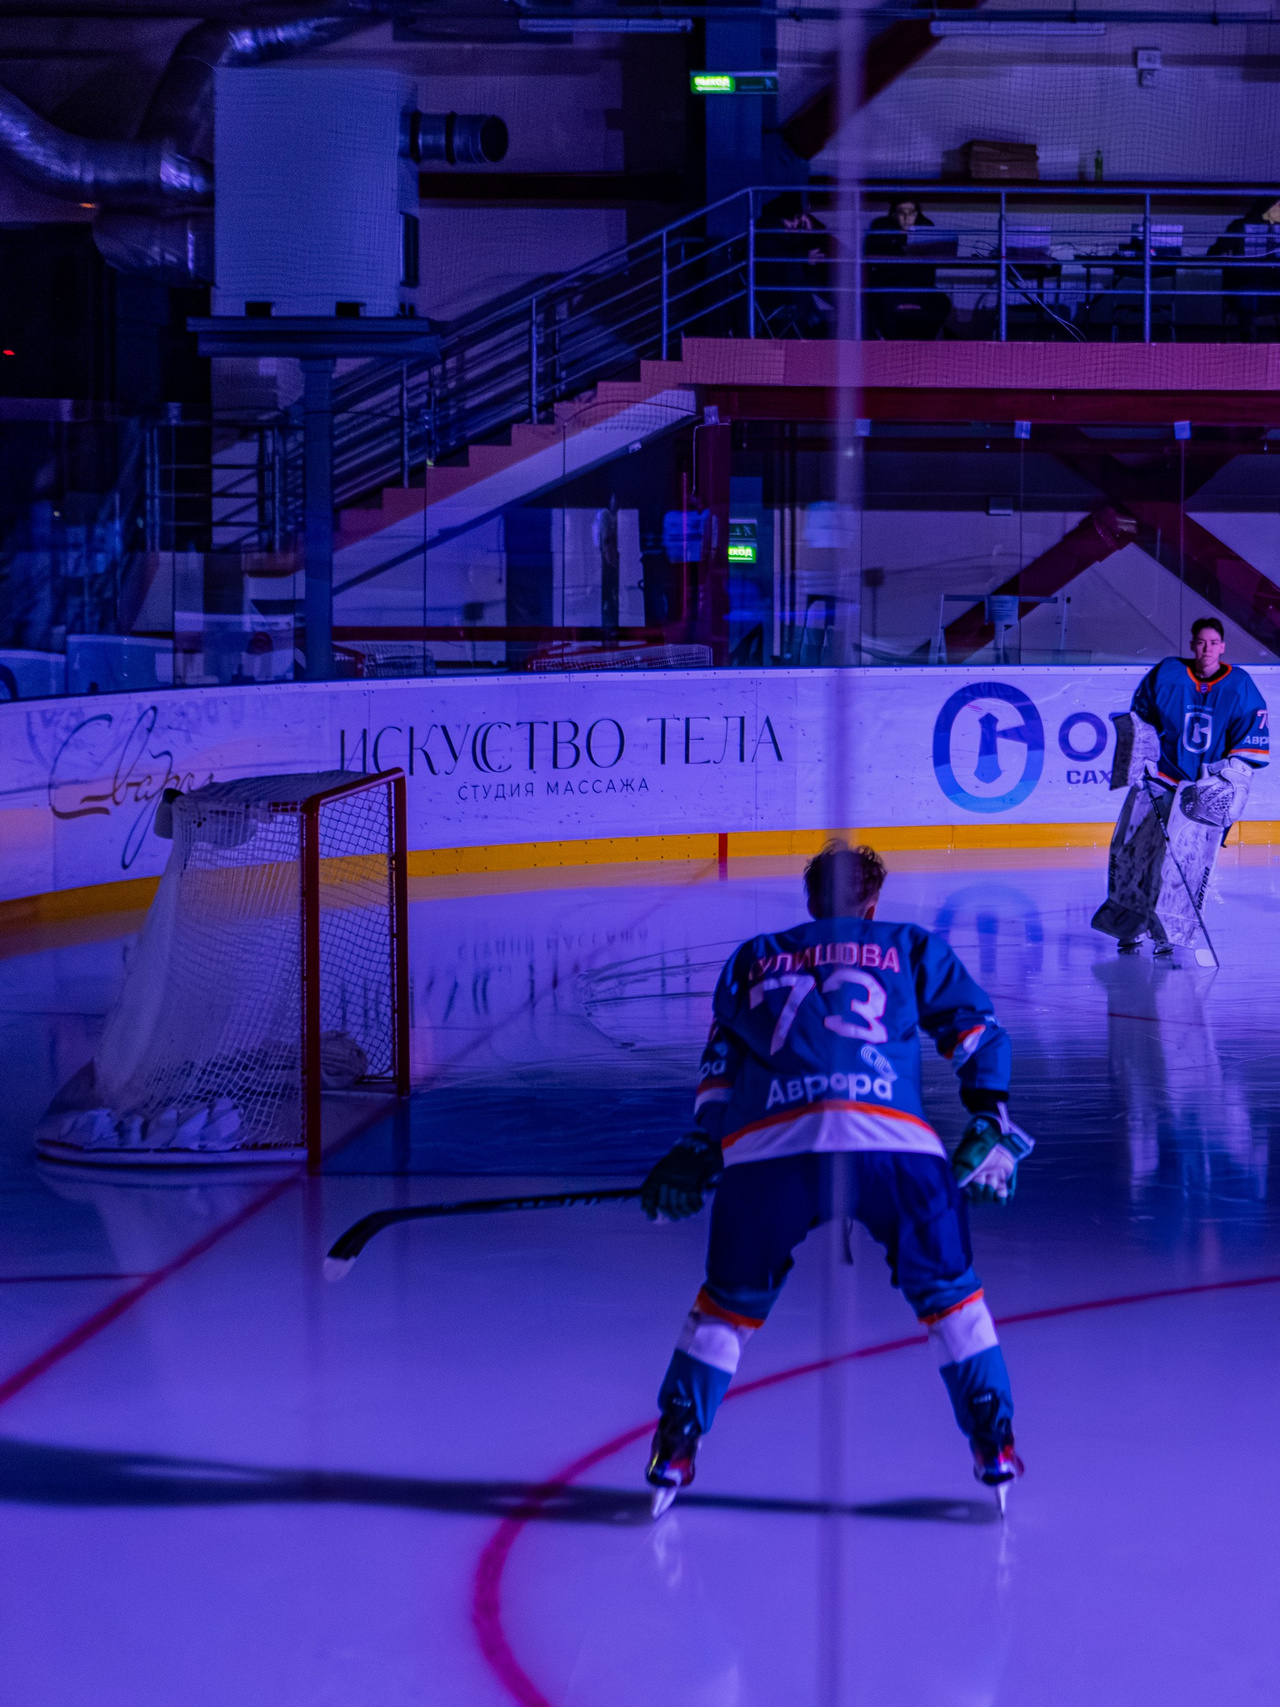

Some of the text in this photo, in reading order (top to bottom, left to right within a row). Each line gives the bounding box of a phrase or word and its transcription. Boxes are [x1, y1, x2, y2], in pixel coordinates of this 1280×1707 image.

[339, 715, 784, 776] ИСКУССТВО ТЕЛА
[458, 777, 650, 801] СТУДИЯ МАССАЖА
[749, 967, 888, 1057] 73
[765, 1071, 895, 1111] Аврора
